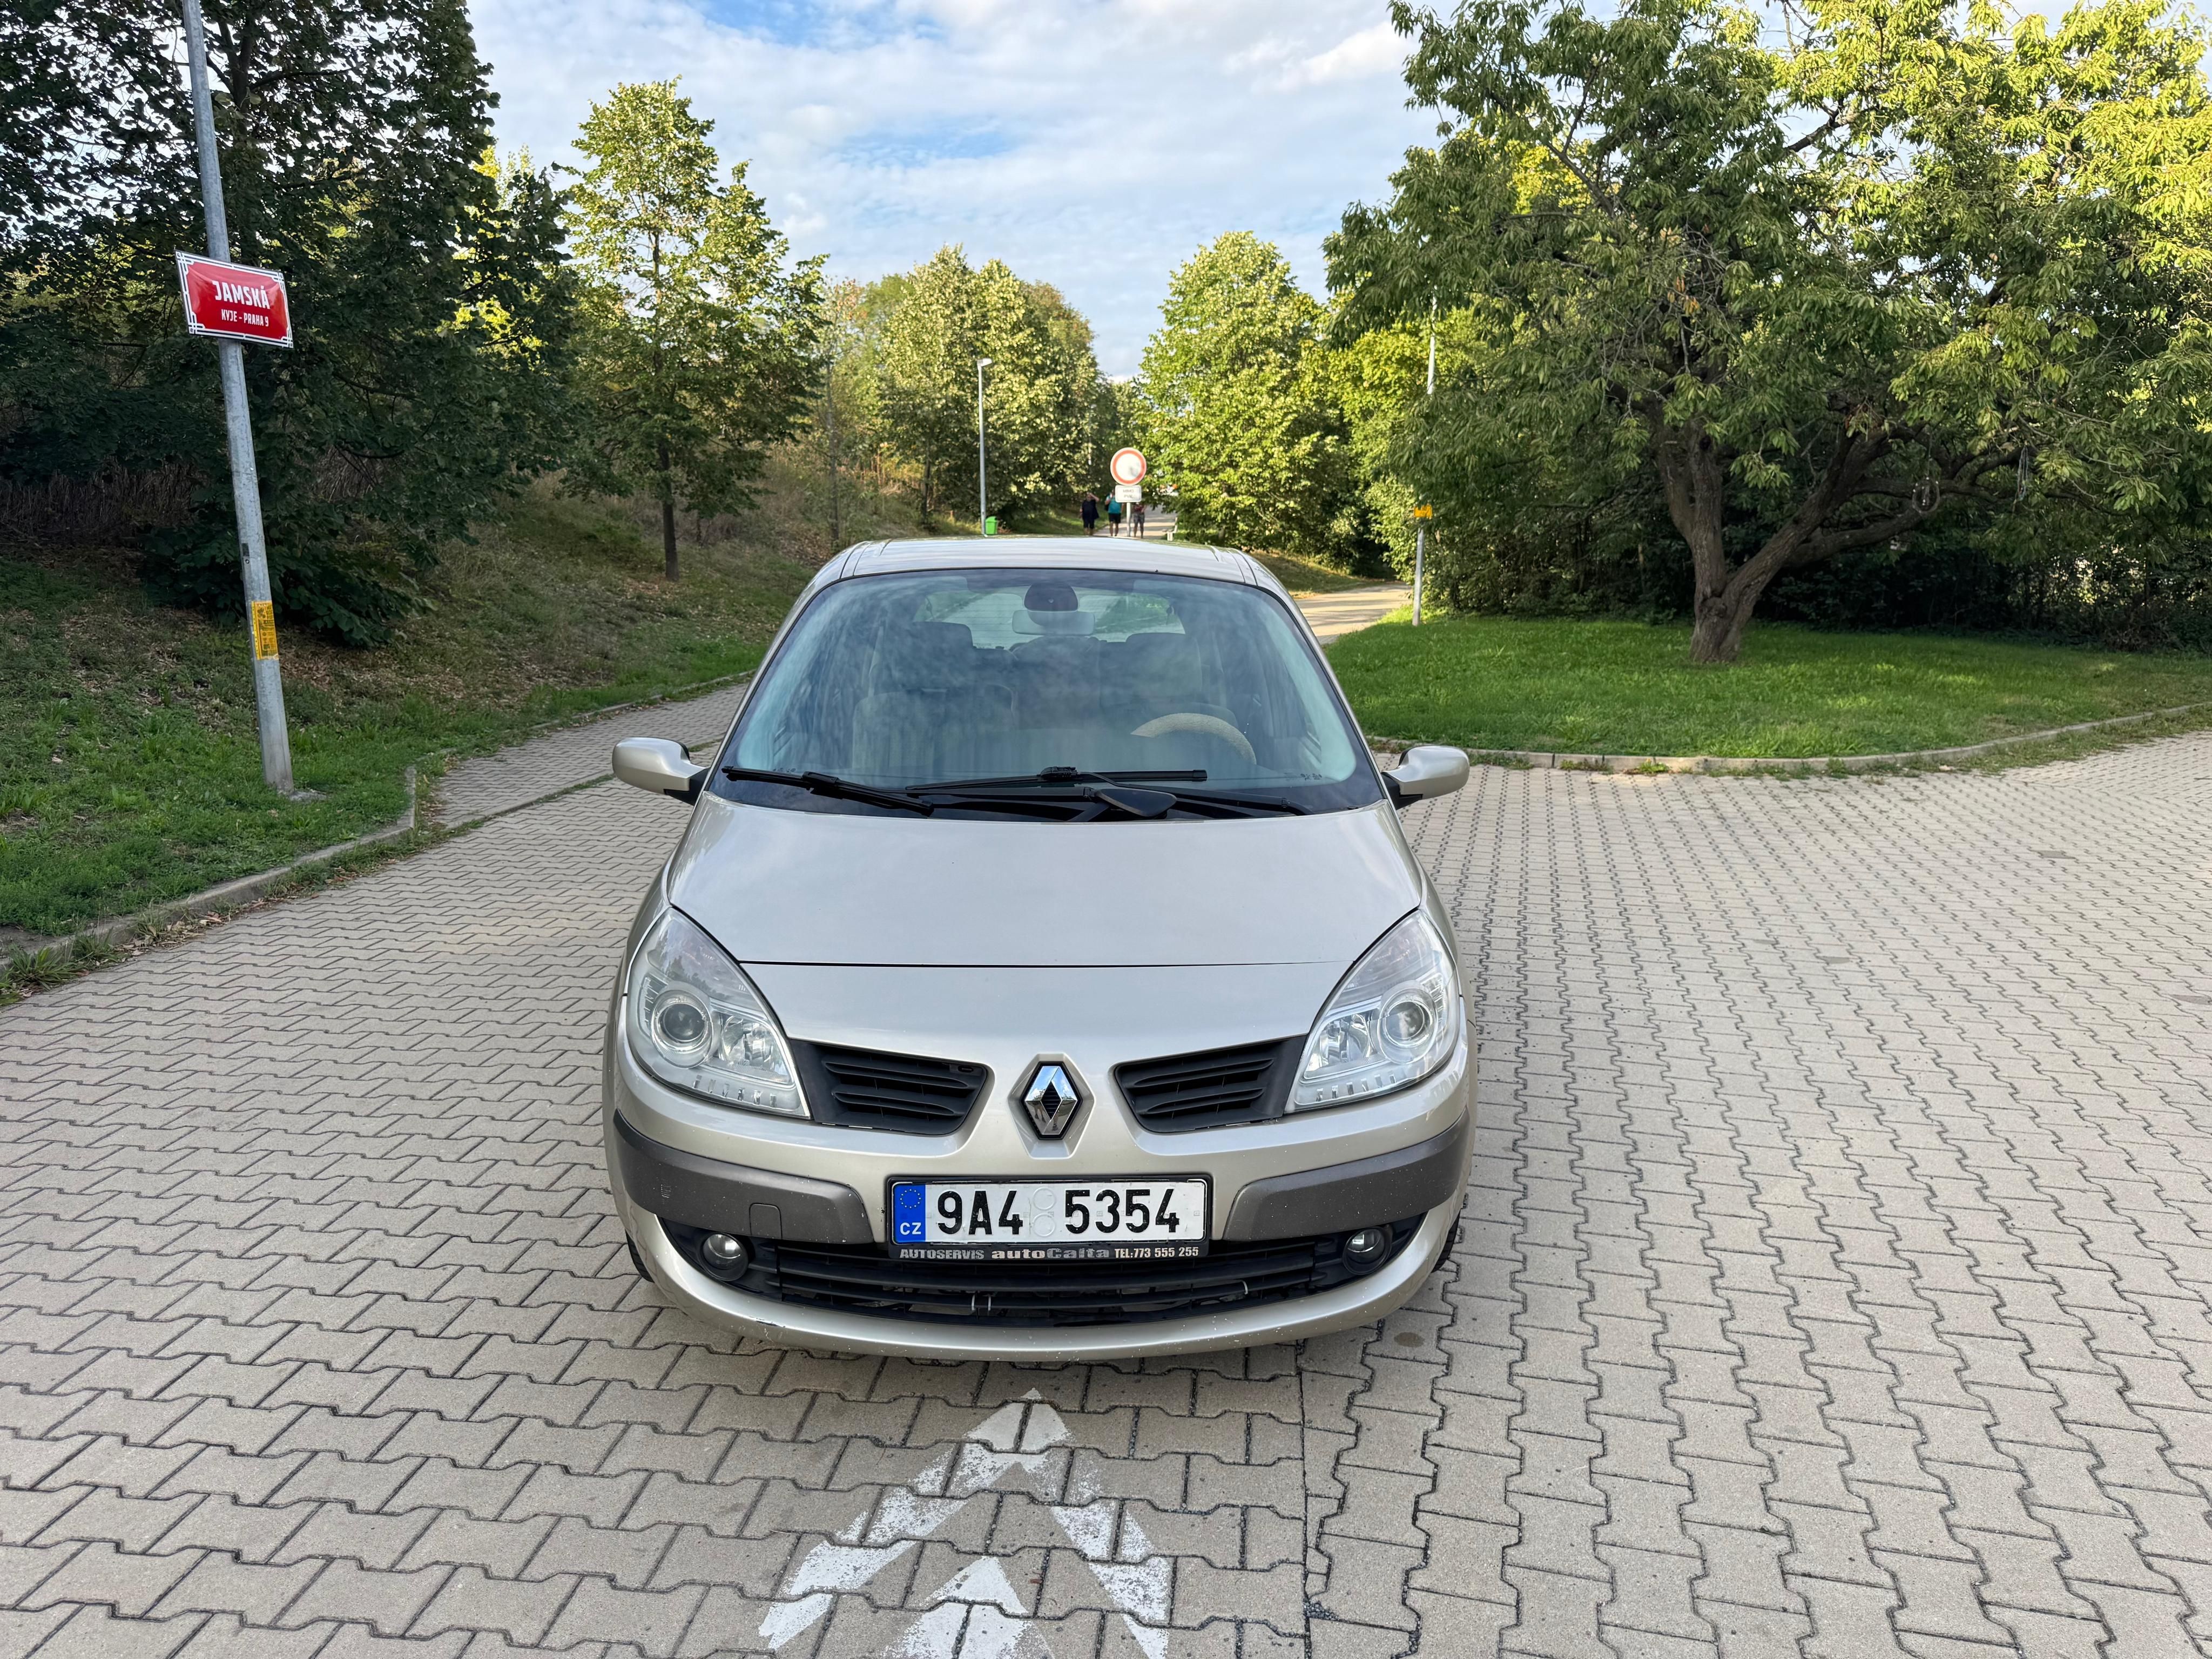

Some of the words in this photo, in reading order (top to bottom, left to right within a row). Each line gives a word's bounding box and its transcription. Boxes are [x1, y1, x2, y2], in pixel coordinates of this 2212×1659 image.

[211, 280, 271, 309] JAMSKÁ
[221, 309, 238, 322] KYJE
[244, 313, 264, 326] PRAHA
[265, 316, 269, 327] 9
[938, 1190, 1024, 1235] 9A4
[1065, 1189, 1180, 1234] 5354
[900, 1222, 921, 1235] CZ
[899, 1249, 984, 1259] AUTOSERVIS
[1155, 1247, 1175, 1257] 555
[1178, 1246, 1199, 1257] 255
